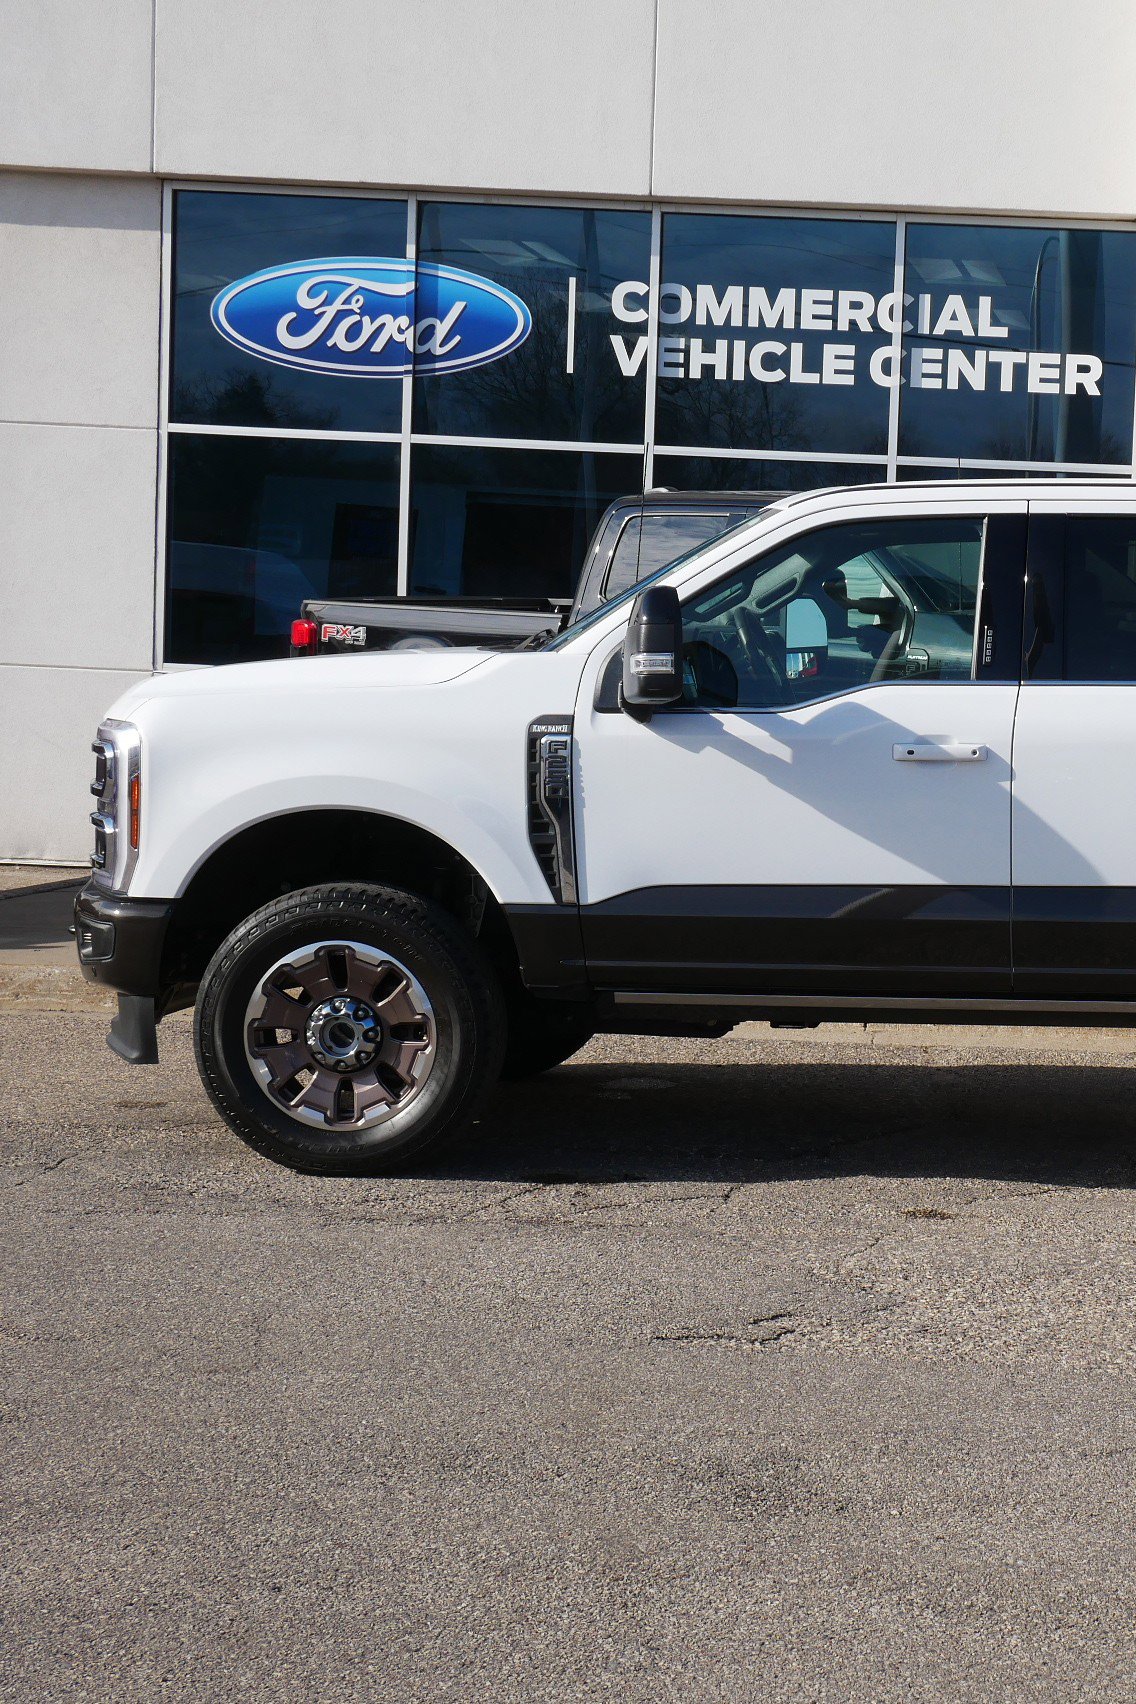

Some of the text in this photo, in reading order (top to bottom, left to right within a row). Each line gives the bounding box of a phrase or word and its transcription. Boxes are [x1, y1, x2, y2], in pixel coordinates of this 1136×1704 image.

[276, 274, 467, 356] Ford
[611, 280, 1009, 338] COMMERCIAL
[609, 334, 1103, 396] VEHICLE CENTER
[321, 624, 366, 643] FX4
[547, 724, 568, 733] RANCH
